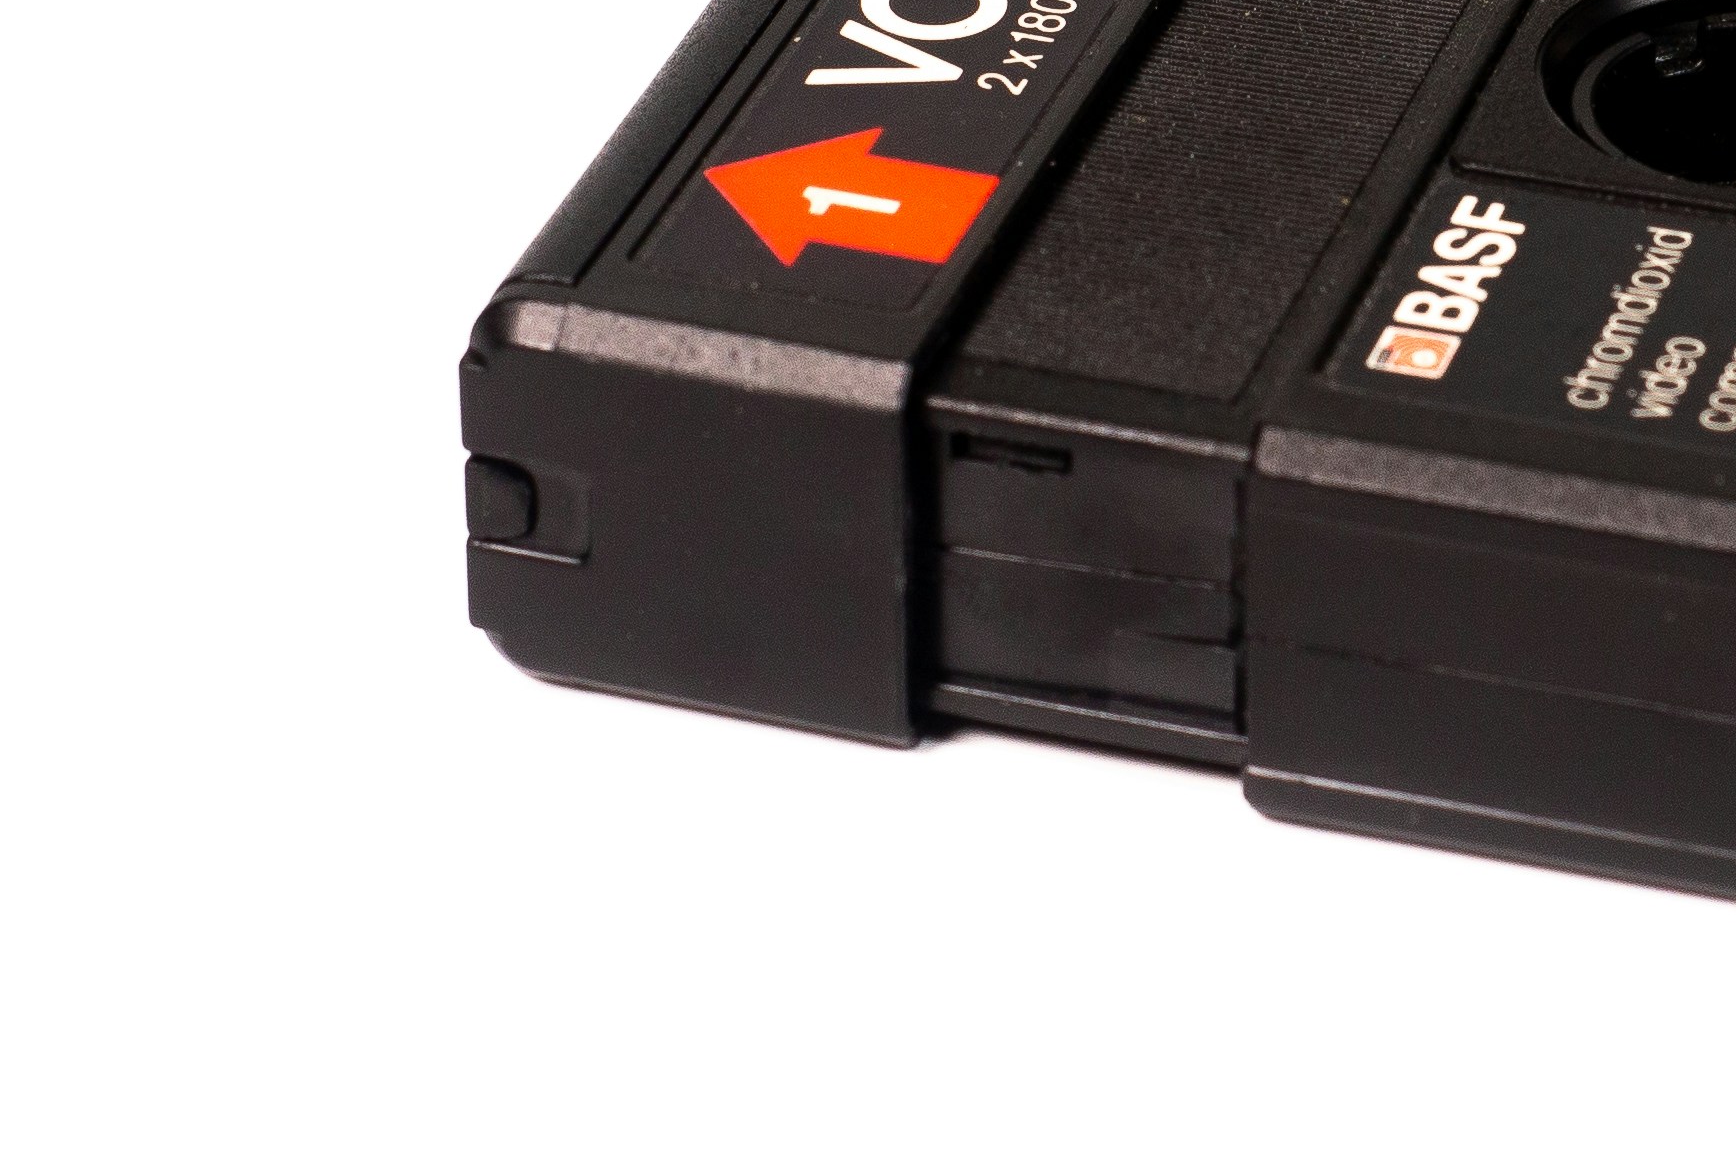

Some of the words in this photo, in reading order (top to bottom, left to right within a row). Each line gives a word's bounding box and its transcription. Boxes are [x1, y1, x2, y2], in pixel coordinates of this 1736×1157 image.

[977, 72, 1028, 96] 2
[1002, 49, 1044, 69] x
[802, 185, 901, 215] 1
[1393, 195, 1526, 333] BASF
[1562, 226, 1694, 410] chromdioxid
[1625, 336, 1707, 419] video
